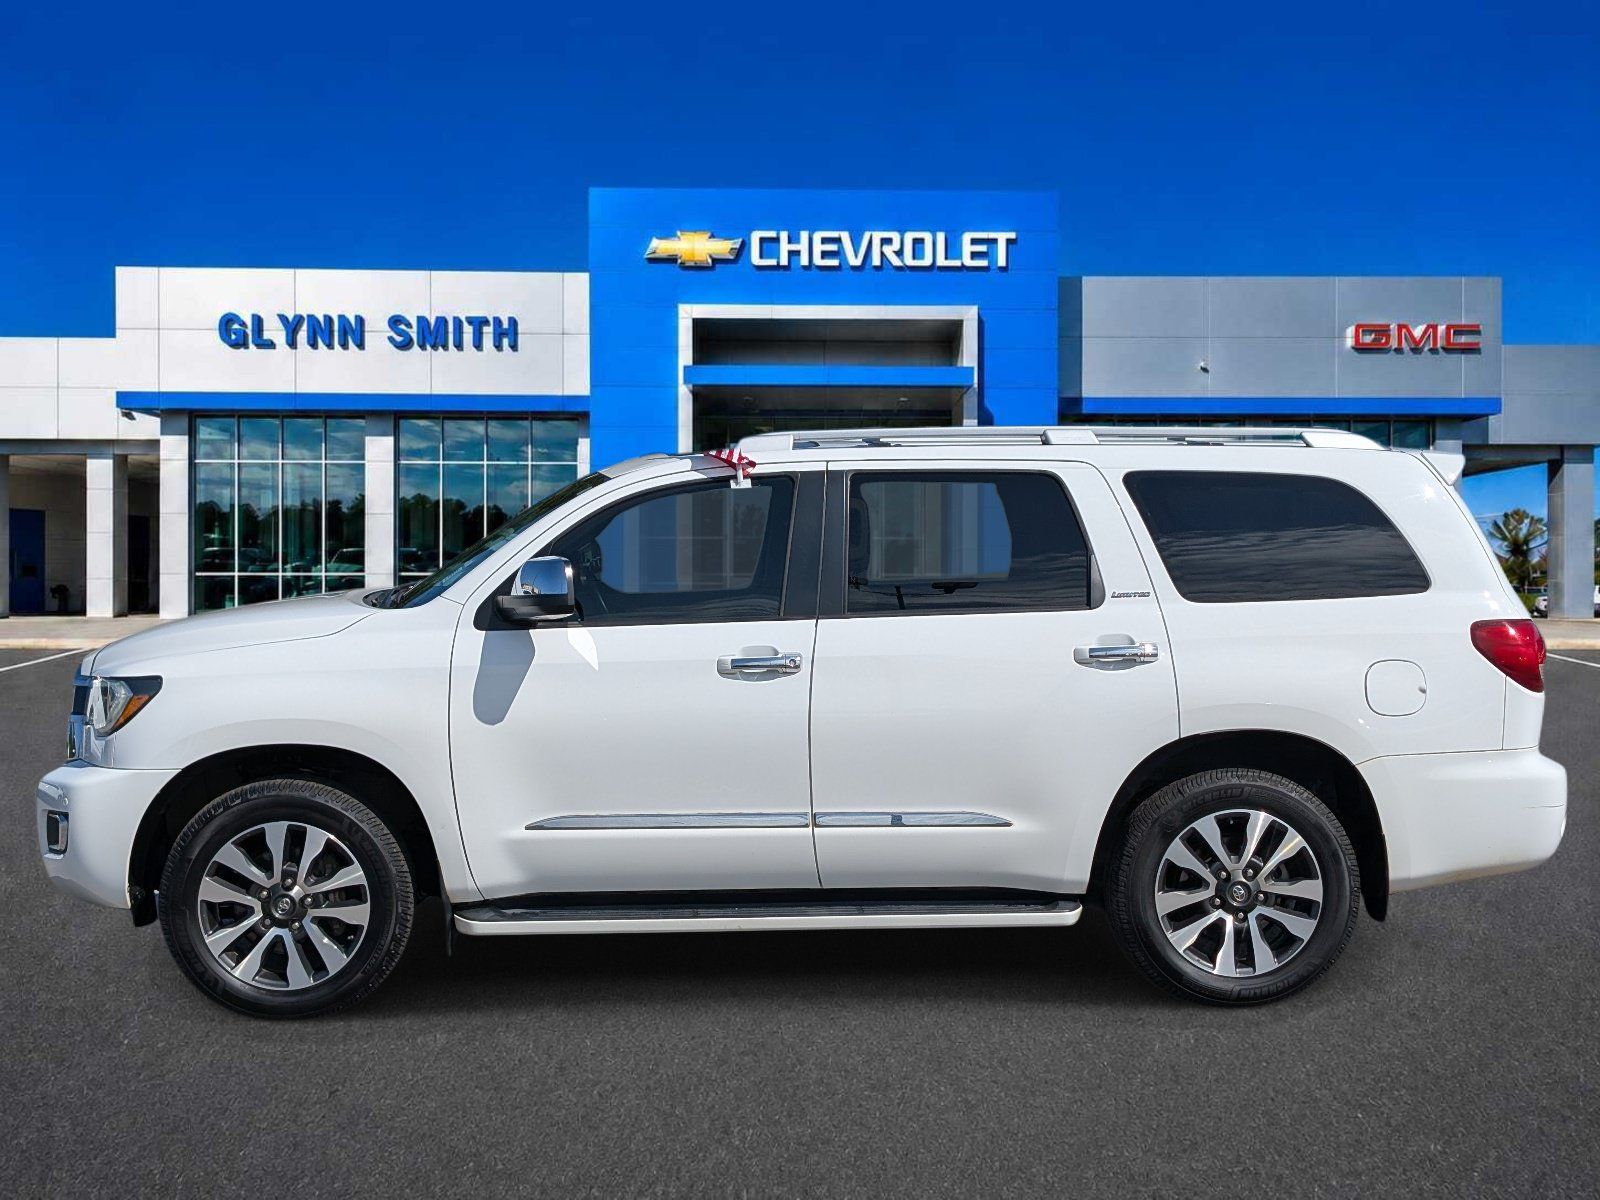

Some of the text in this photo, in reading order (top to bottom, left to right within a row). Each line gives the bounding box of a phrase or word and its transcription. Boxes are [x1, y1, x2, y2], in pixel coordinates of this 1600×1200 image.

[750, 230, 1017, 269] CHEVROLET
[218, 312, 519, 352] GLYNN SMITH
[1351, 323, 1482, 352] GMC
